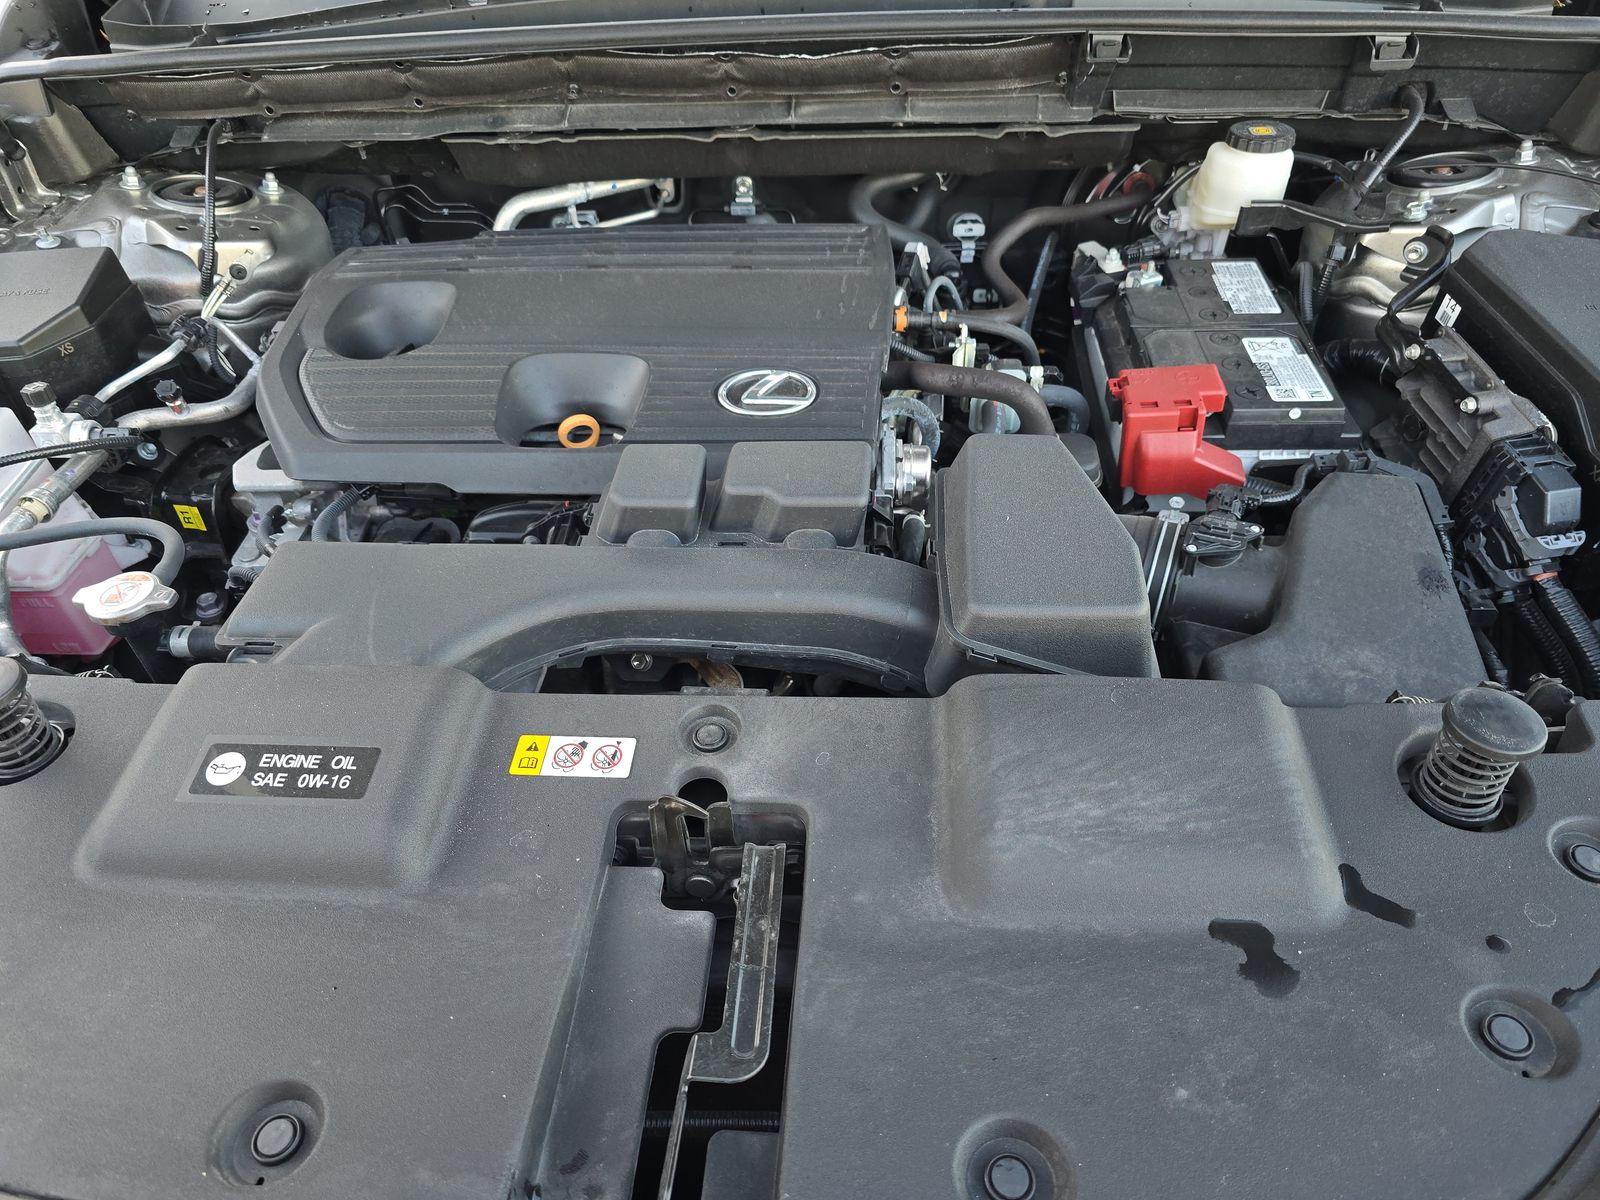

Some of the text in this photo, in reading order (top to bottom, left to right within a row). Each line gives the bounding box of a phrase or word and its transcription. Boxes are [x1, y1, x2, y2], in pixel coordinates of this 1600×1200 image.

[1445, 297, 1458, 315] 14
[57, 342, 74, 357] XS
[180, 511, 194, 524] R1
[258, 754, 357, 769] ENGINE OIL
[251, 772, 352, 790] SAE 0W-16
